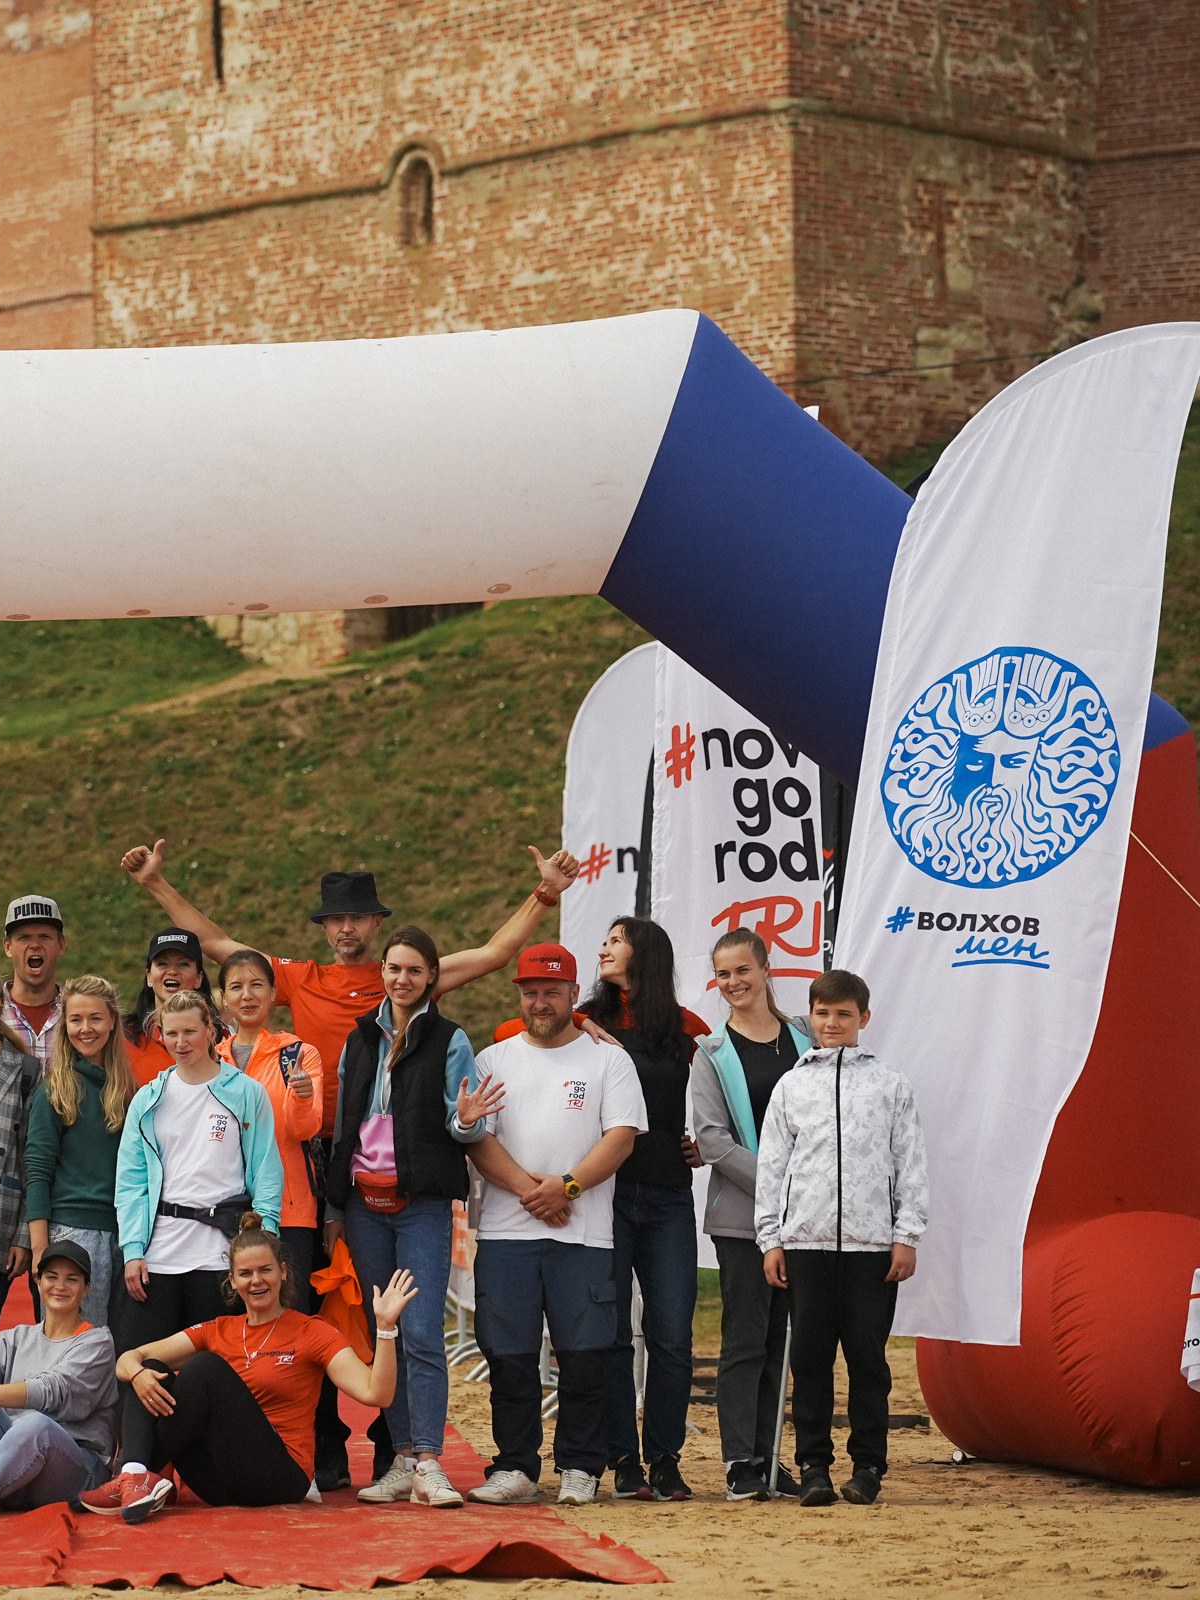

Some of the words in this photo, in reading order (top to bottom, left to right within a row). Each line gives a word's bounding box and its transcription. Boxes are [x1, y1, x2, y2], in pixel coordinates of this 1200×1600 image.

[732, 776, 813, 838] go
[714, 817, 821, 884] rod
[13, 902, 53, 920] PUMA
[955, 935, 1050, 960] мен
[569, 1091, 585, 1099] rod
[573, 1086, 586, 1094] go
